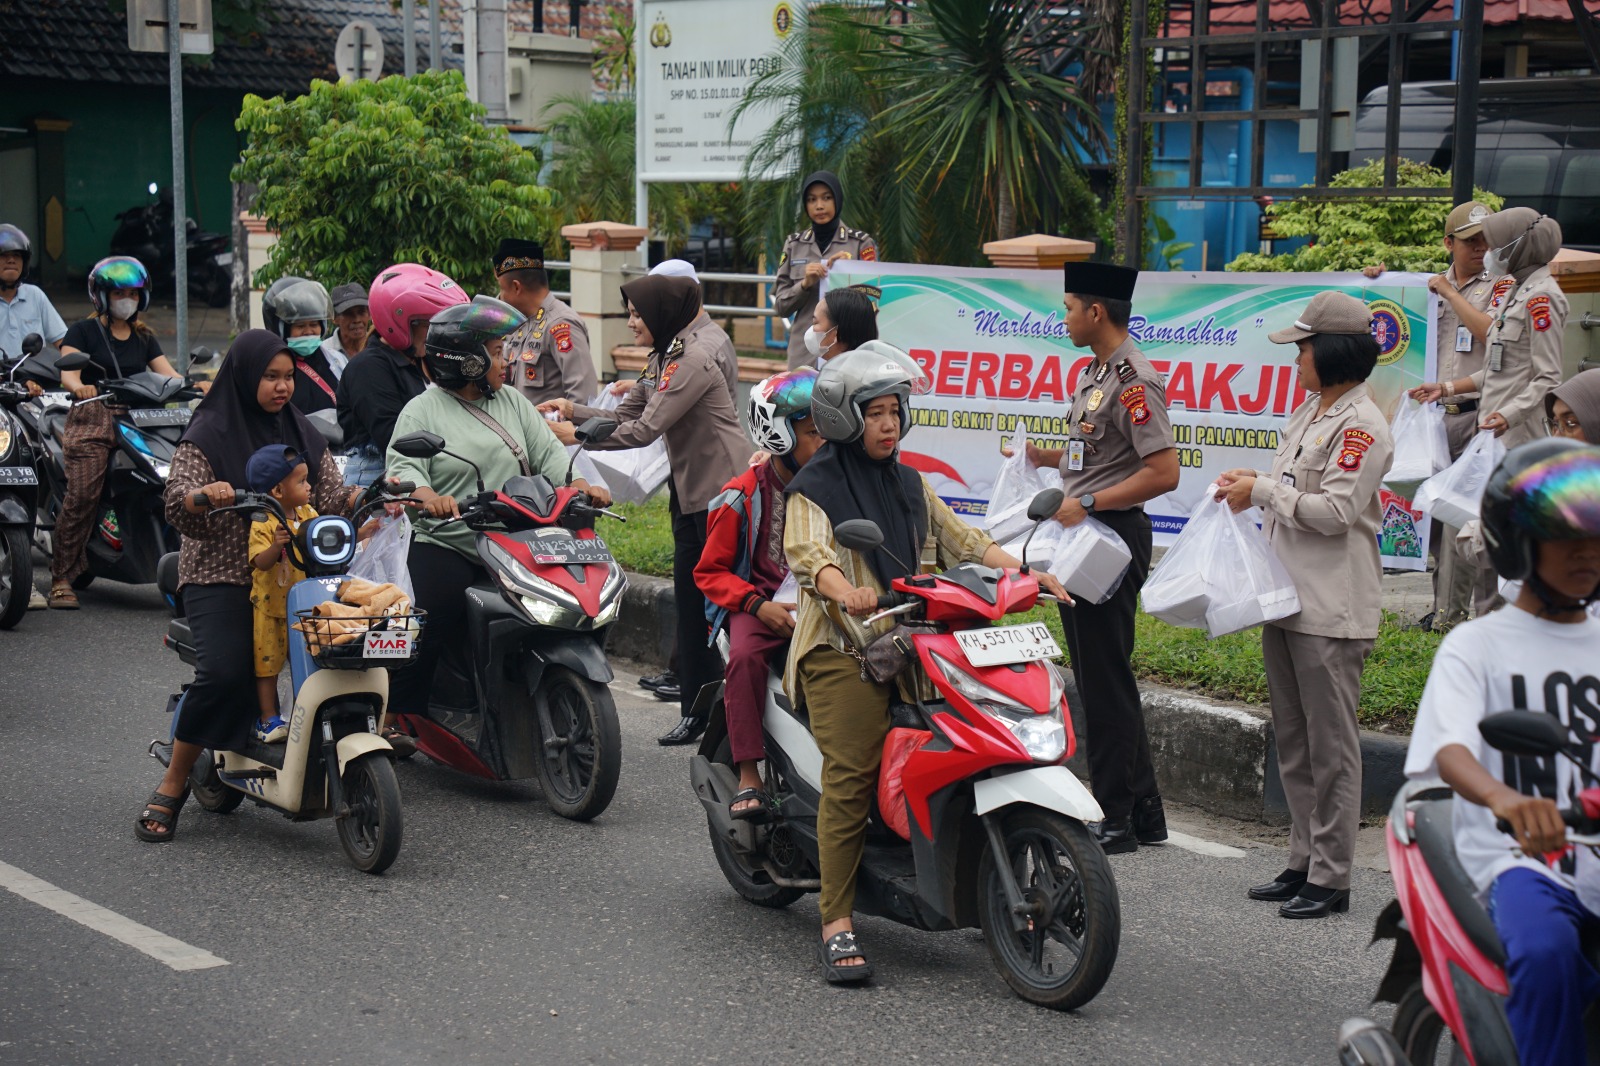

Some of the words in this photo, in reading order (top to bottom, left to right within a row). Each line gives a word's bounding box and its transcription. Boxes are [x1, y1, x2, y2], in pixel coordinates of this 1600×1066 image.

[661, 61, 697, 80] TANAH
[700, 60, 714, 79] INI
[717, 59, 747, 78] MILIK
[670, 89, 684, 100] SHP
[685, 88, 699, 99] NO.
[1127, 315, 1238, 343] Ramadhan
[1121, 386, 1143, 400] POLDA
[951, 410, 994, 431] SAKIT
[1195, 425, 1279, 450] PALANGKA
[1346, 430, 1372, 442] POLDA
[17, 468, 33, 476] YB
[317, 577, 342, 585] VIAR
[367, 639, 407, 649] VIAR
[960, 633, 982, 648] KH
[984, 629, 1025, 646] 5570
